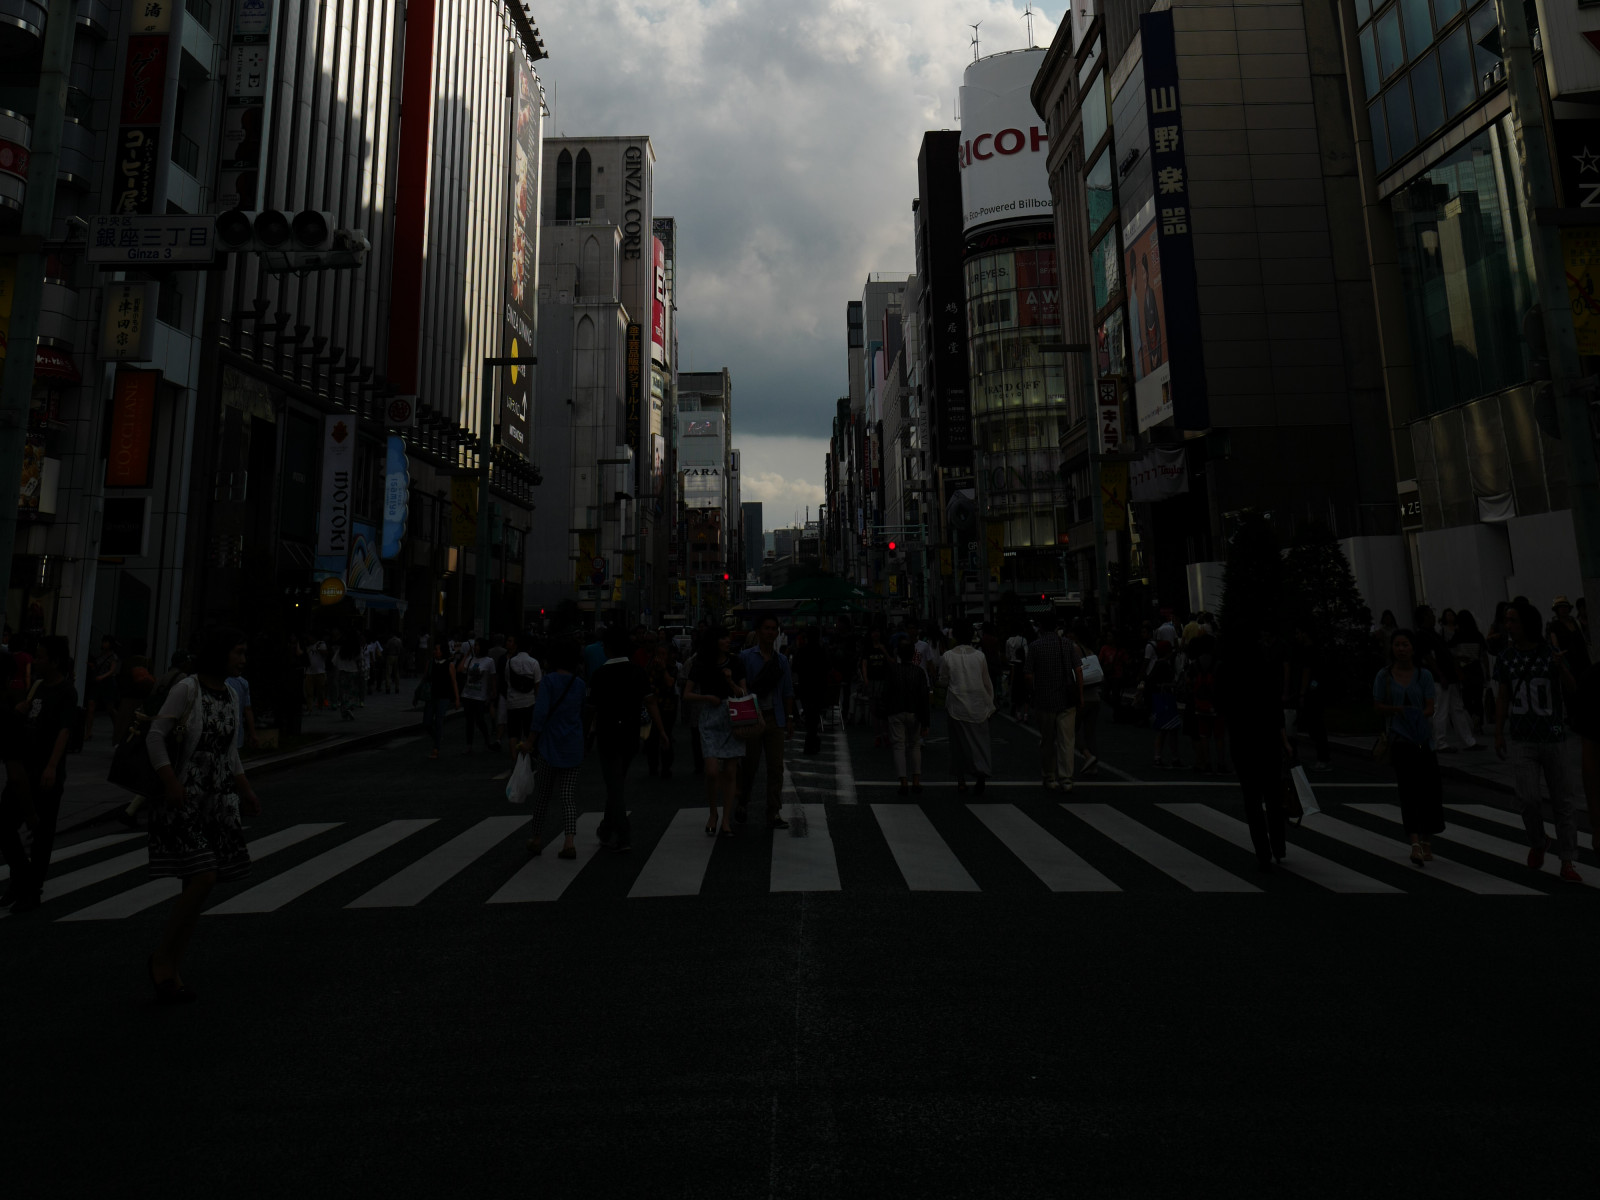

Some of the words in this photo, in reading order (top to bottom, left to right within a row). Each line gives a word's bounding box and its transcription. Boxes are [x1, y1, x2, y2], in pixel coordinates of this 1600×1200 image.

[116, 129, 145, 213] コーヒー屋
[958, 127, 1048, 169] RICOH
[1151, 85, 1189, 237] 山野楽器
[625, 146, 642, 205] GINZA
[97, 216, 133, 227] 中央区
[969, 201, 1017, 221] Eco-Powered
[1018, 198, 1053, 210] Billboa
[95, 228, 207, 248] 銀座三丁目
[127, 248, 160, 260] Ginza
[164, 249, 172, 259] 3
[624, 208, 642, 261] CORE
[945, 302, 959, 354] 鳩居堂
[115, 379, 138, 477] L'OCCITANE
[920, 411, 928, 448] TASAKI
